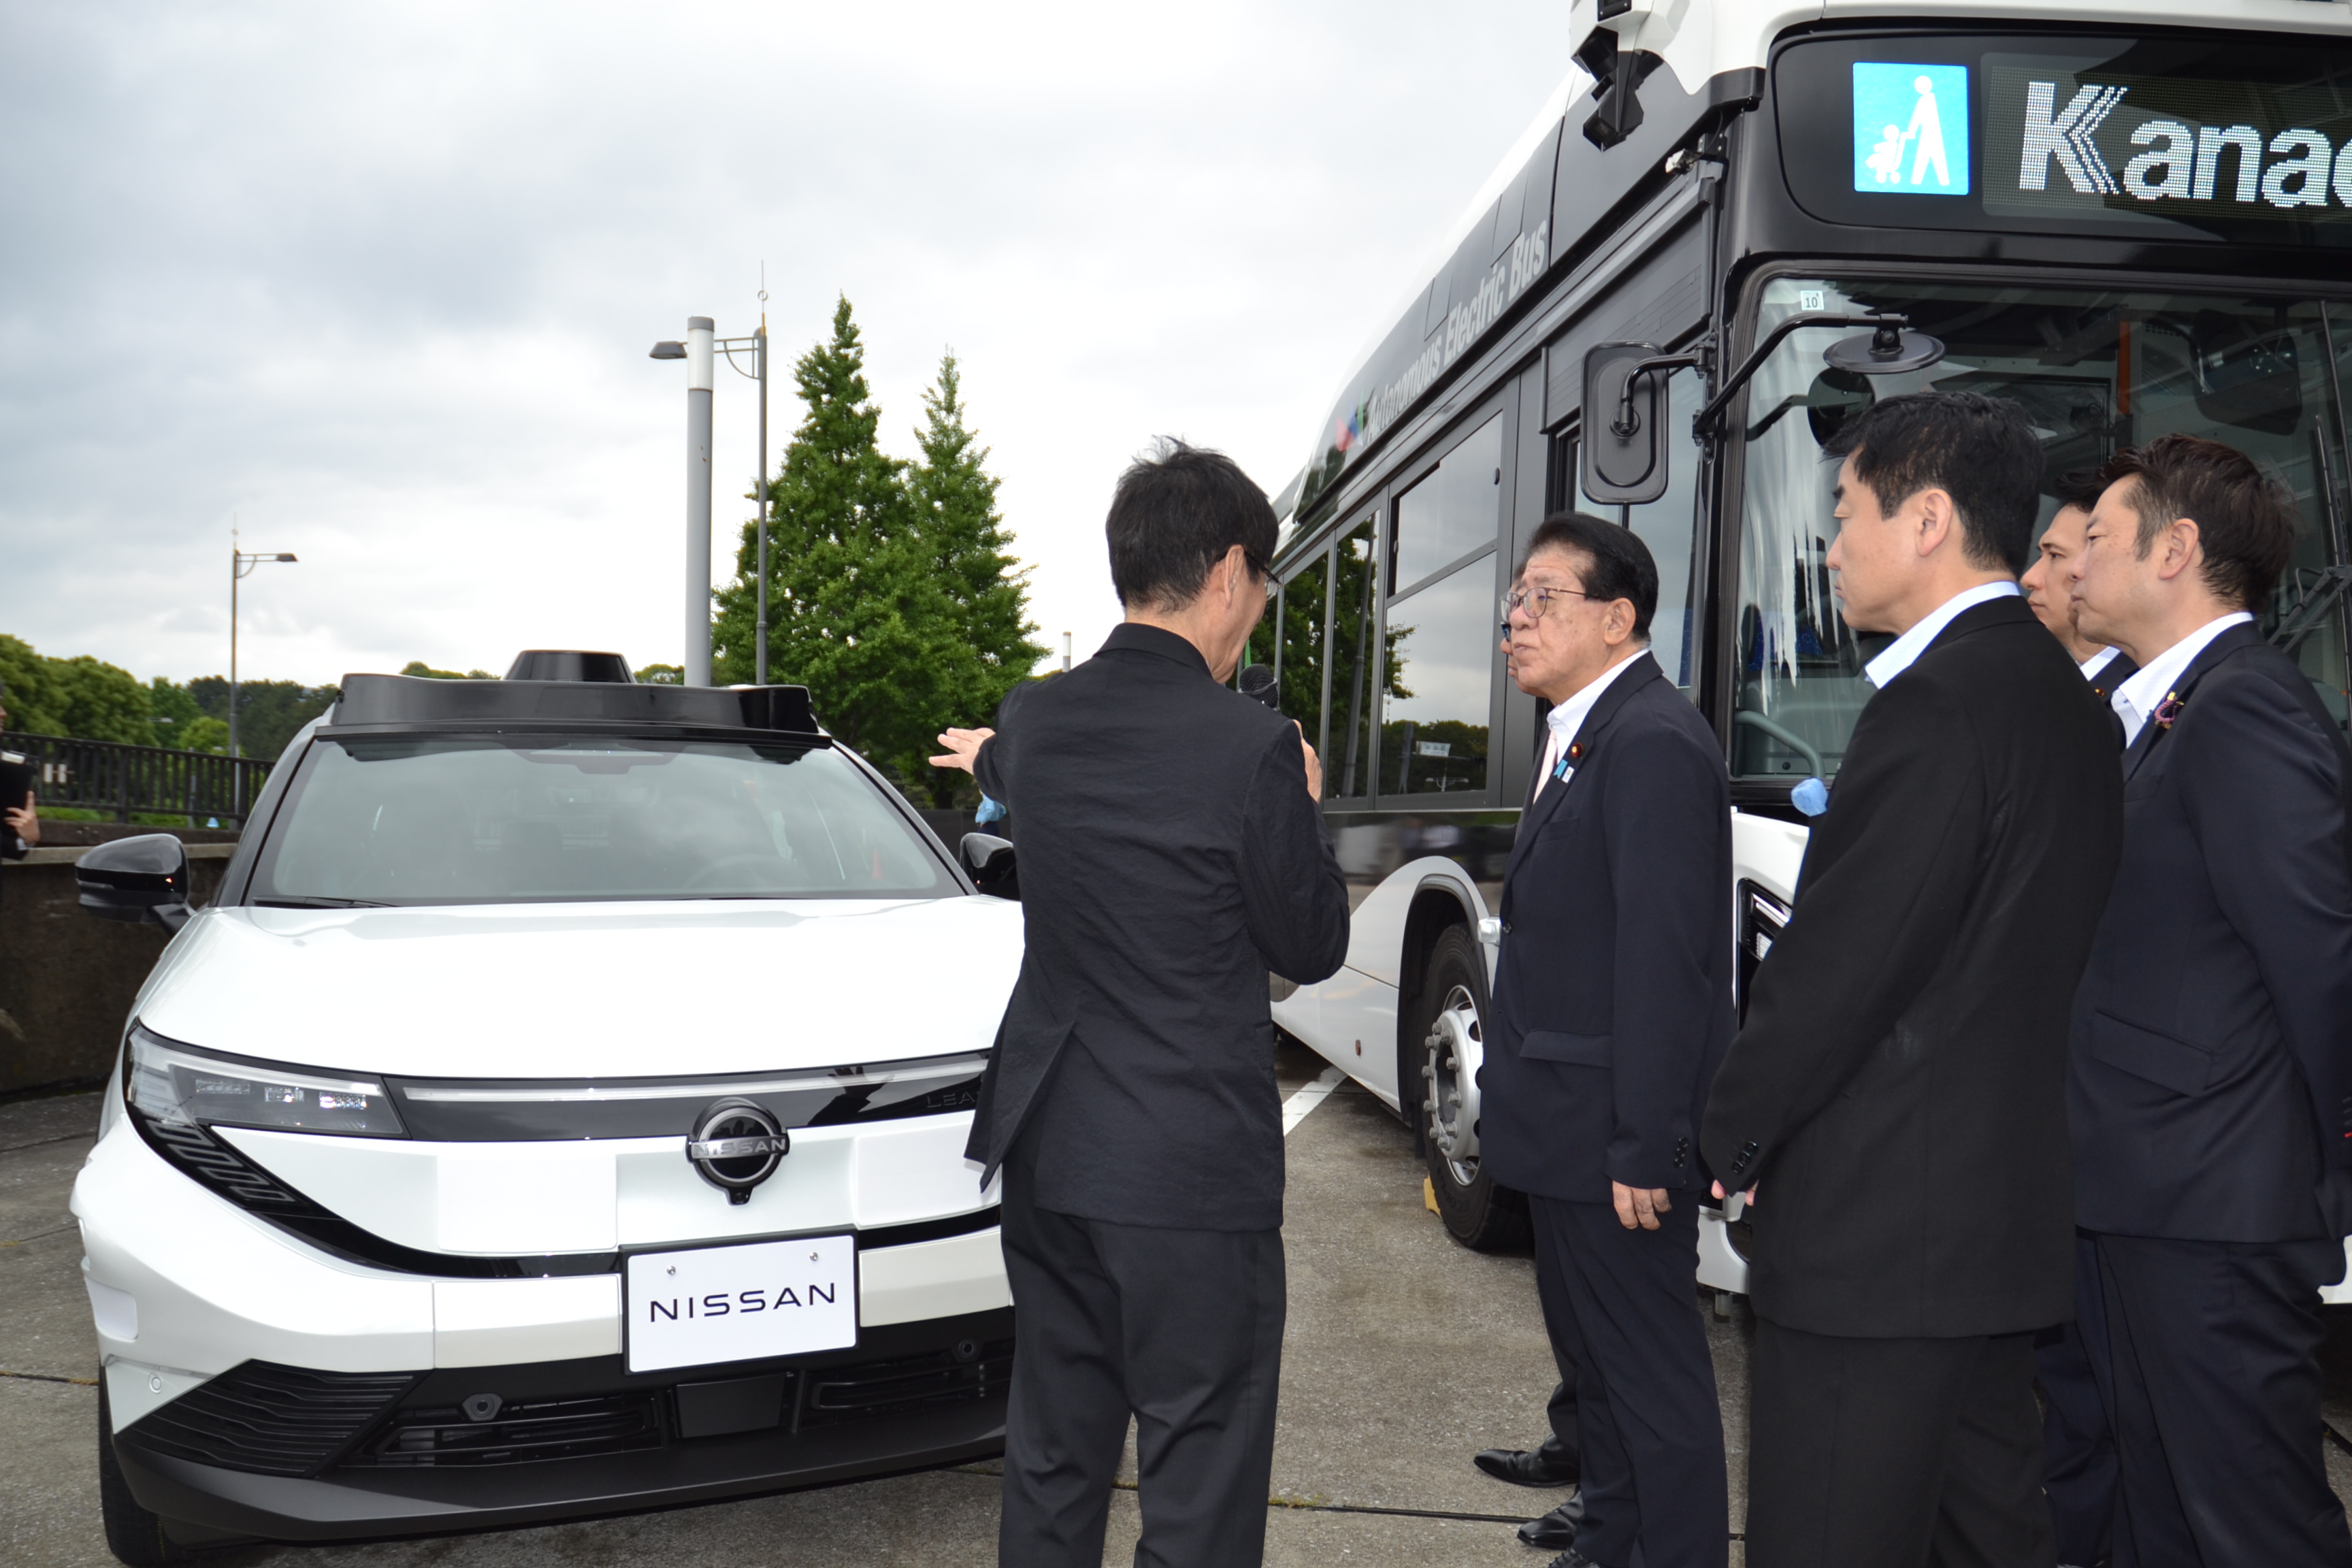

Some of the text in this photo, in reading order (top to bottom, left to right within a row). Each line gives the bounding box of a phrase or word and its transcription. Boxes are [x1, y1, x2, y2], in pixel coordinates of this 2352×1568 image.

[1367, 220, 1547, 444] Autonomous Electric Bus
[927, 1091, 980, 1108] LEA
[693, 1139, 786, 1157] NISSAN
[651, 1282, 835, 1322] NISSAN
